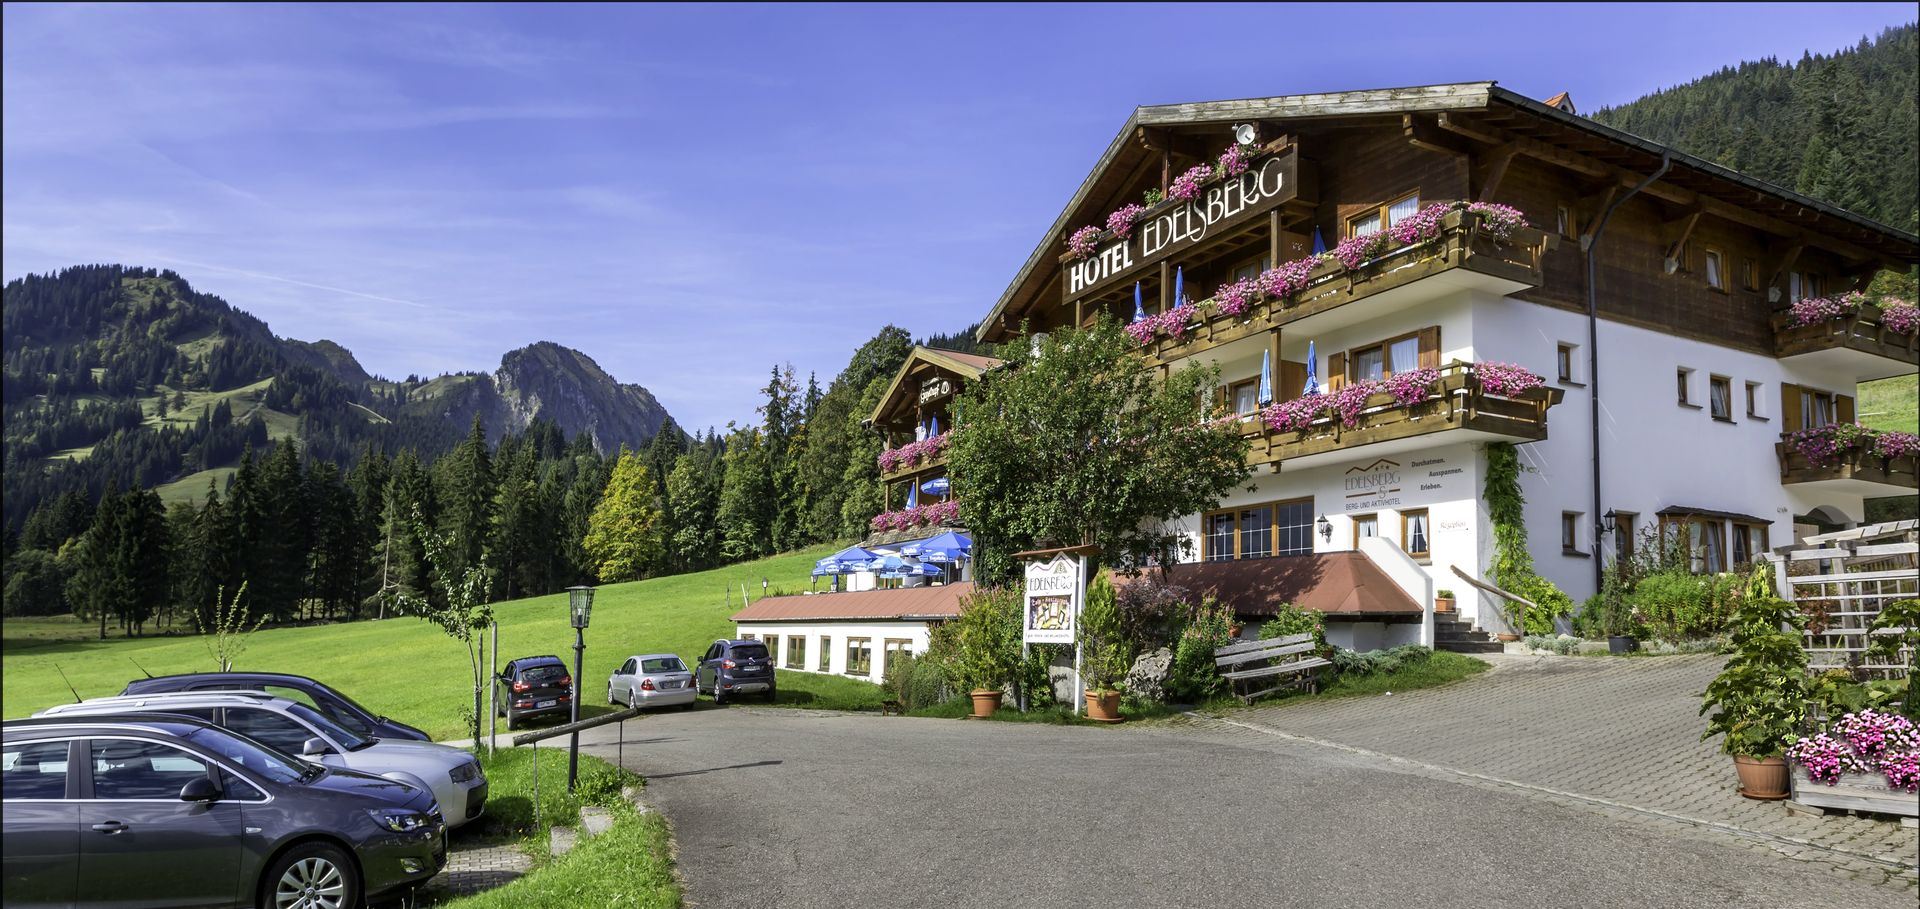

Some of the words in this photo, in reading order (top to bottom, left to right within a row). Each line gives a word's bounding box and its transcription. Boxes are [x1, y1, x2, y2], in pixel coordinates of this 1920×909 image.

[1070, 239, 1134, 294] HOTEL
[1142, 157, 1284, 258] EDELSBERG
[1345, 471, 1401, 491] EDELSBERG
[1420, 483, 1442, 491] Erleben.
[1359, 501, 1370, 509] UND
[1370, 497, 1401, 508] AKTIVHOTEL
